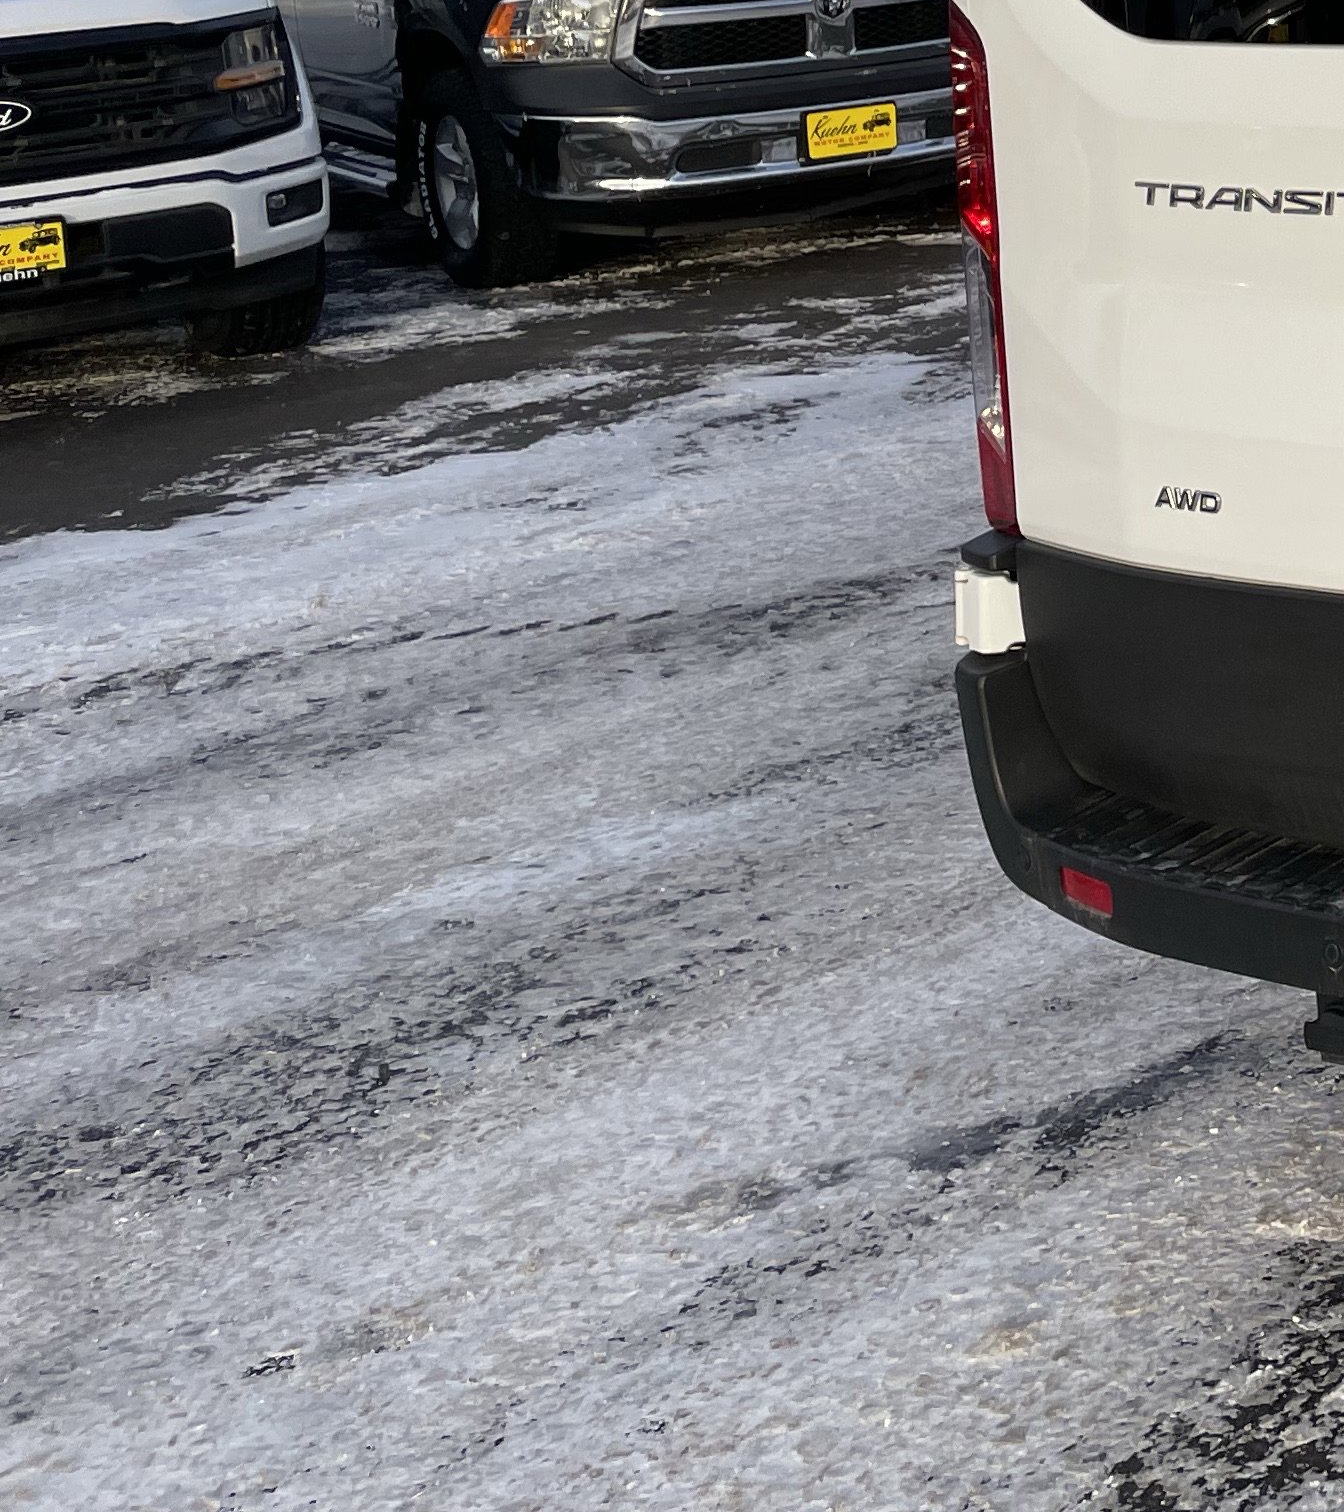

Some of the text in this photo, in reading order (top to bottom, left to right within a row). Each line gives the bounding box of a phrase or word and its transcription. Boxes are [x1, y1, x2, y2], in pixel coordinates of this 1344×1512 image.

[810, 115, 858, 140] Kuehn
[848, 131, 890, 143] COMPANY
[418, 121, 438, 239] GLADIATOR
[0, 268, 38, 283] ehn
[1155, 486, 1222, 514] AWD
